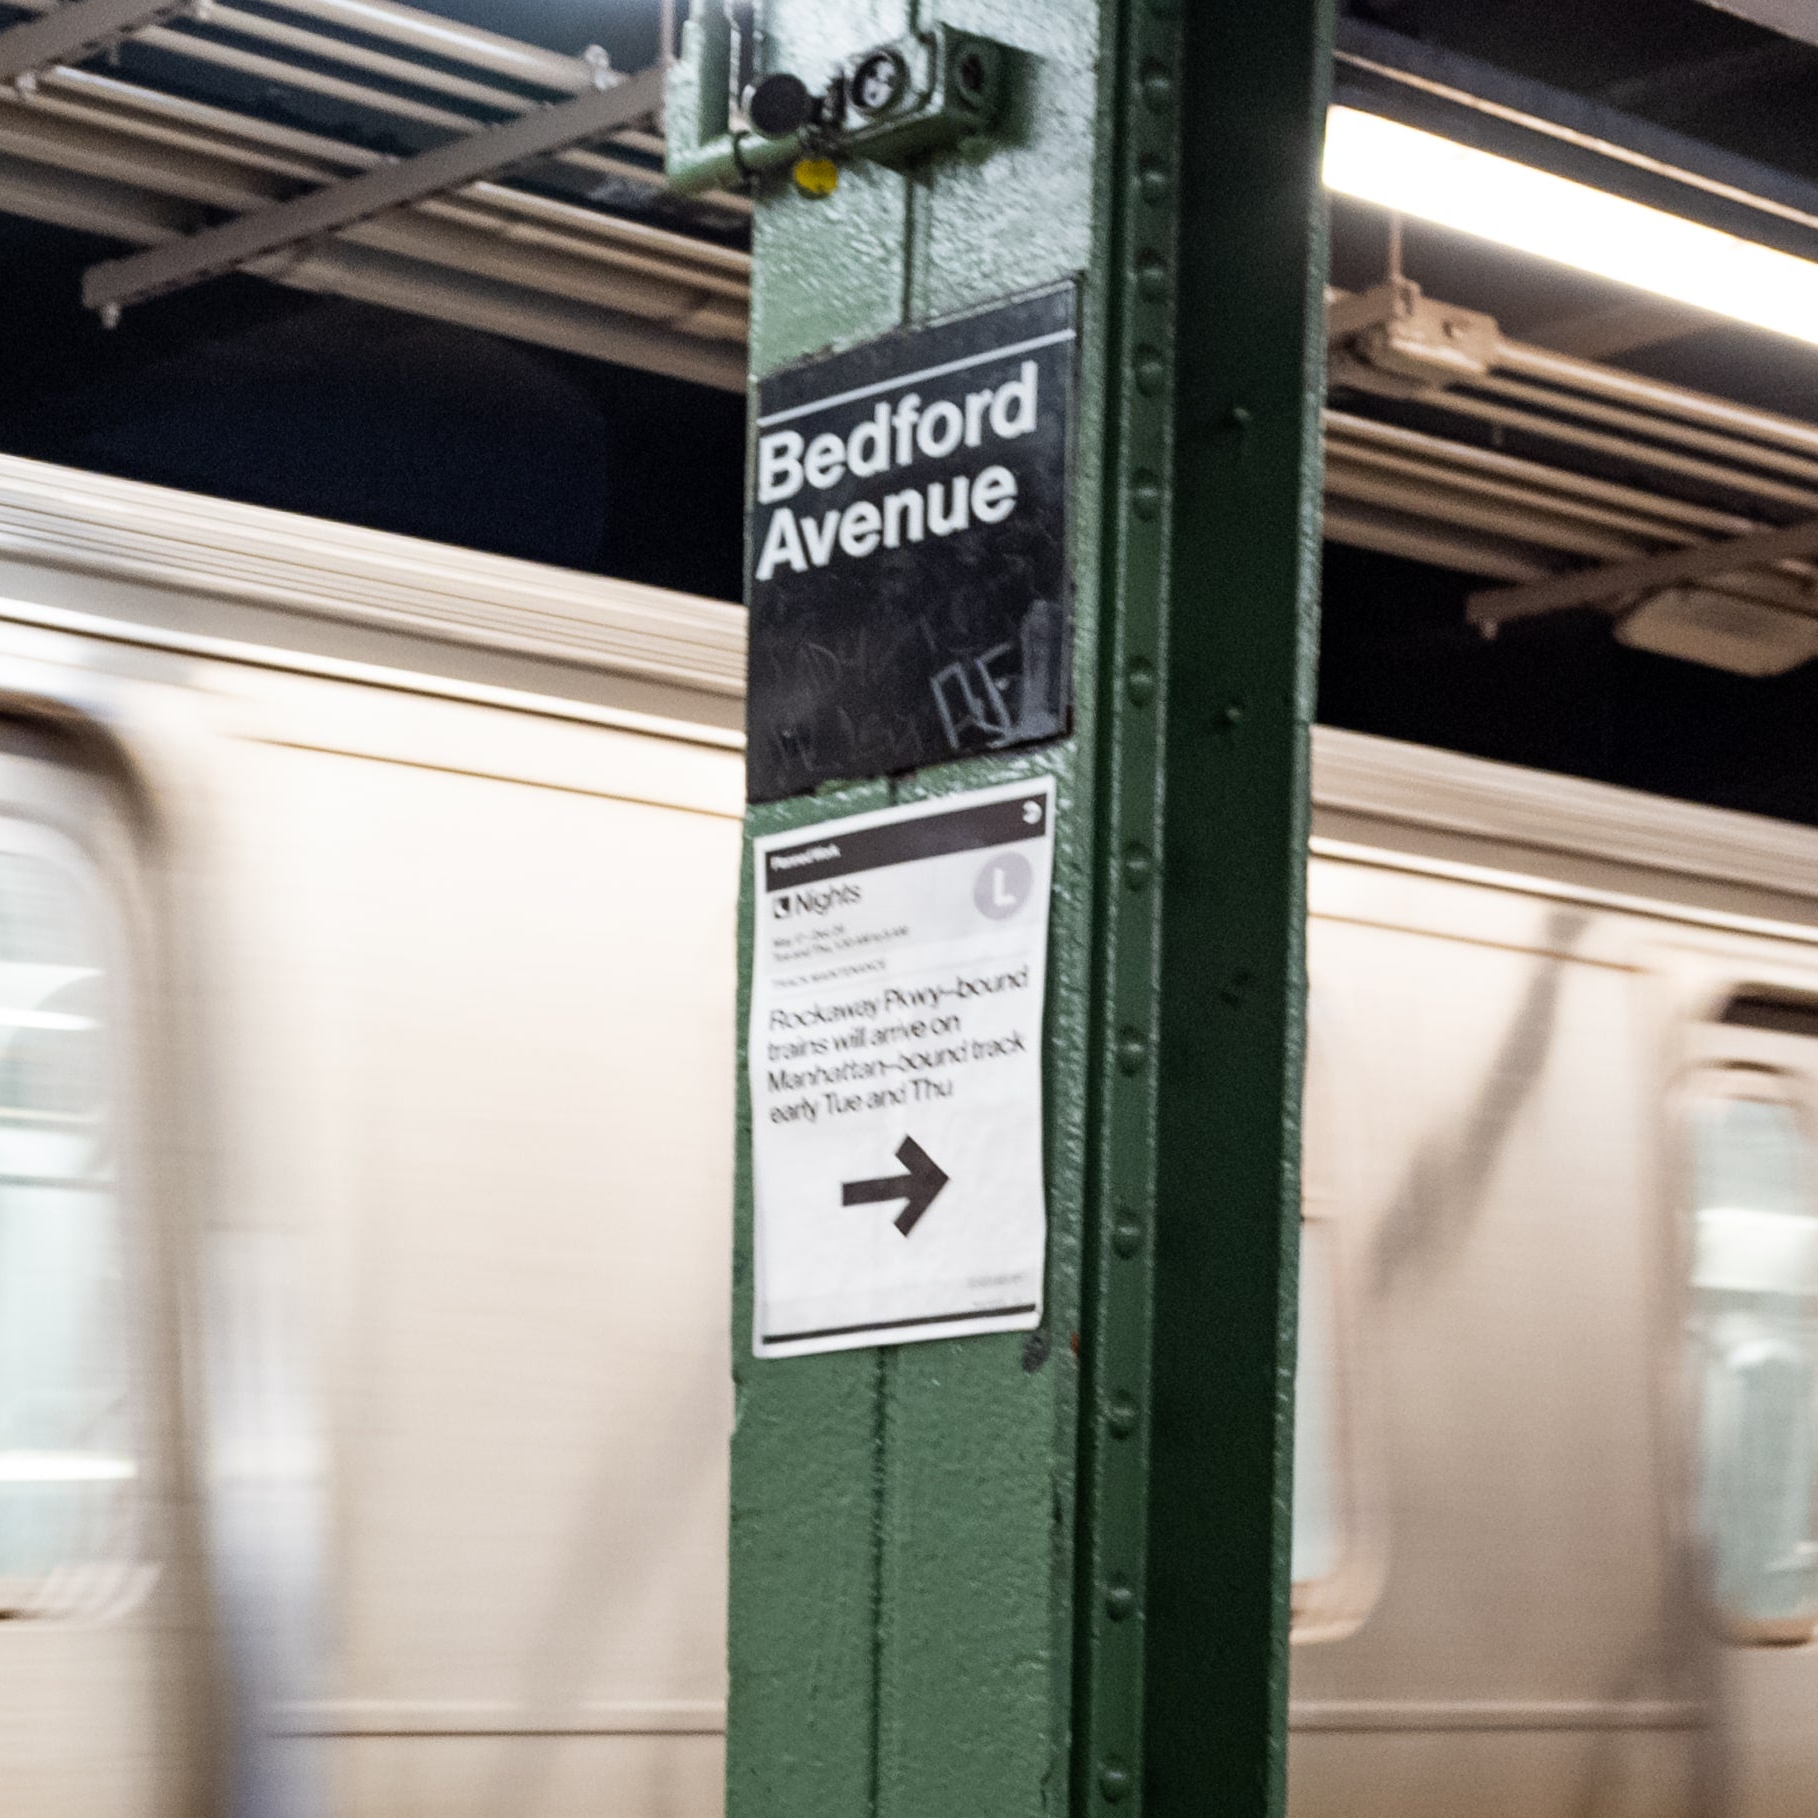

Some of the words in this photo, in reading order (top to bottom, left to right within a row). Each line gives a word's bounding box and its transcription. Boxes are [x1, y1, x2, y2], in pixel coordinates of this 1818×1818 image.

[757, 359, 1039, 505] Bedford
[755, 464, 1018, 581] Avenue
[795, 882, 862, 916] Nights
[993, 868, 1016, 907] L
[766, 1036, 830, 1061] trains
[832, 1026, 866, 1051] will
[869, 1018, 926, 1047] arrive
[930, 1012, 961, 1036] on
[769, 1002, 878, 1031] Rockaway
[971, 1030, 1027, 1060] track
[770, 1098, 817, 1125] early
[821, 1089, 863, 1115] Tue
[866, 1085, 906, 1111] and
[909, 1076, 954, 1103] Thu
